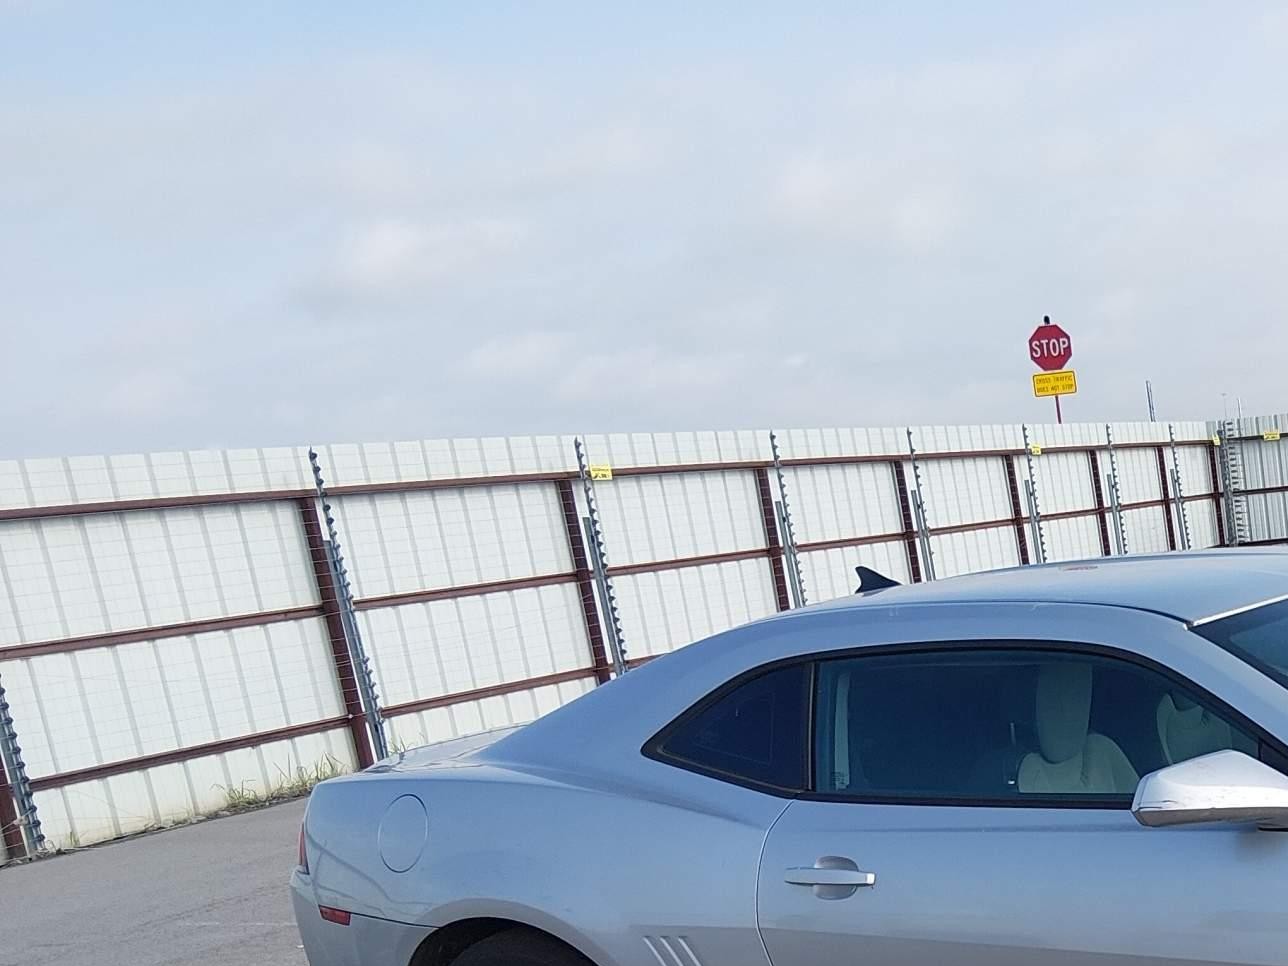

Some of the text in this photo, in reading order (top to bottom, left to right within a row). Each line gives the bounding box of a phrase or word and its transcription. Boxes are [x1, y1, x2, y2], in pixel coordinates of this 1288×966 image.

[1031, 337, 1069, 358] STOP
[1051, 384, 1060, 392] NOT
[1062, 383, 1074, 391] STOP
